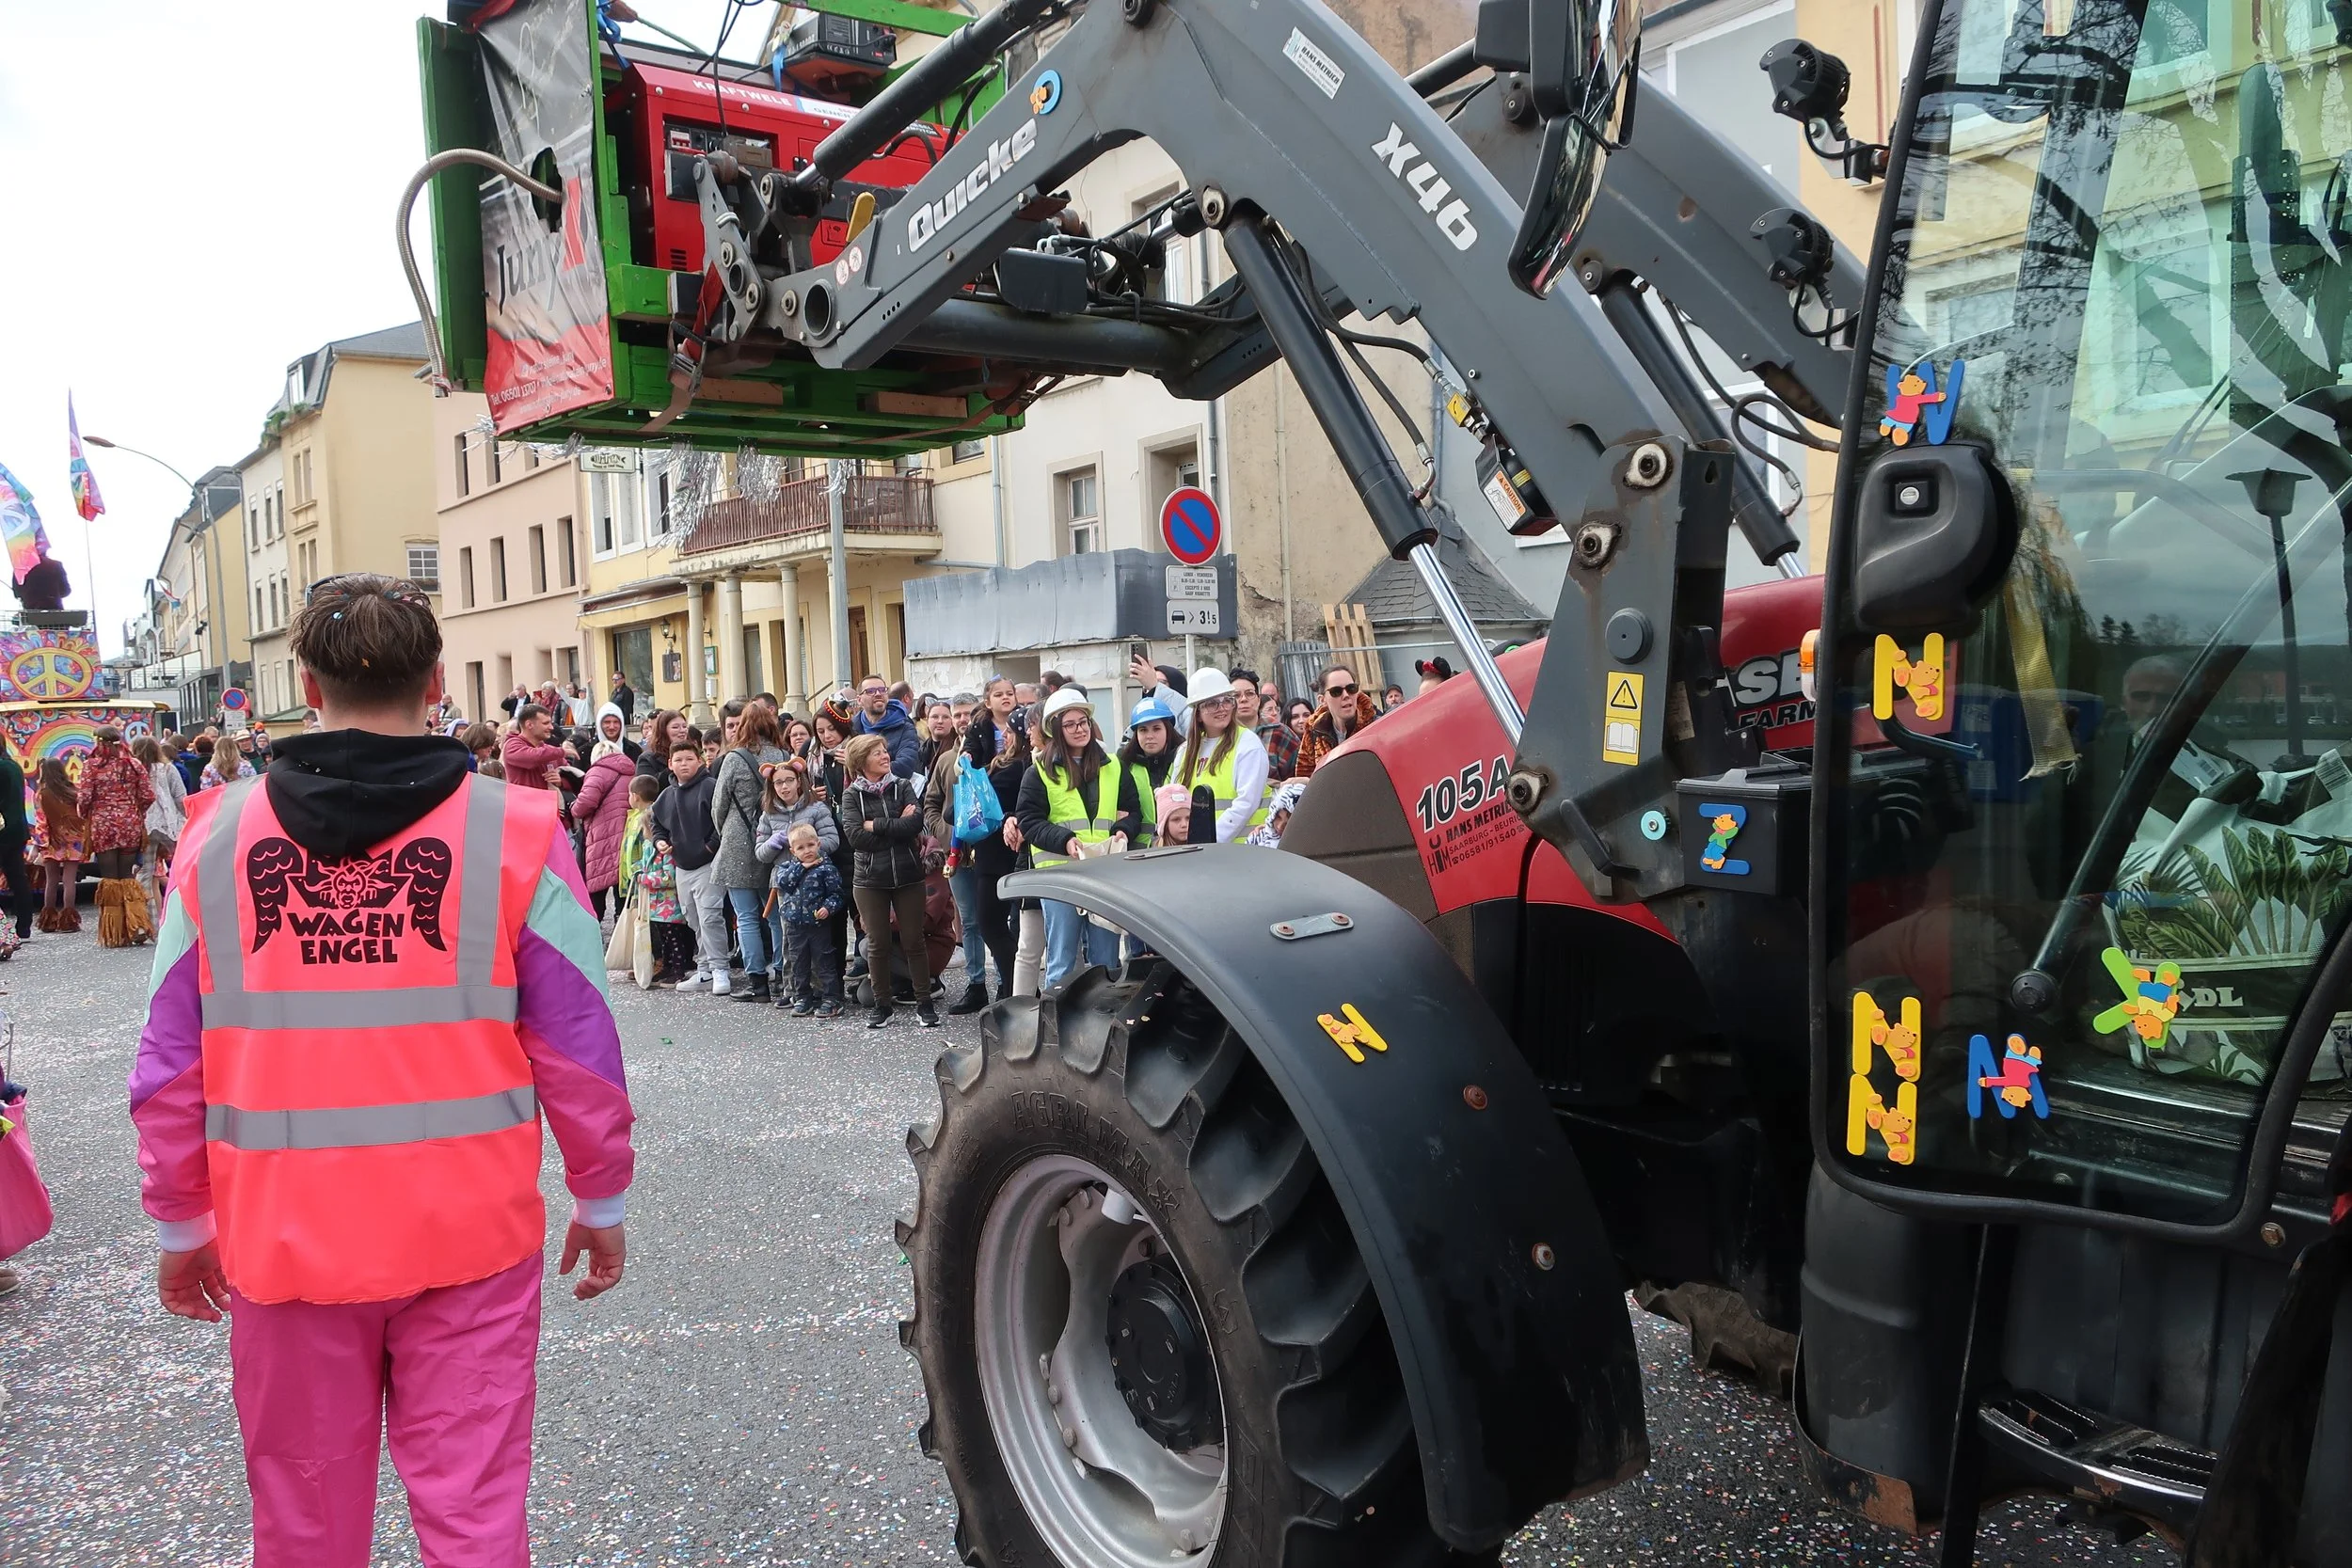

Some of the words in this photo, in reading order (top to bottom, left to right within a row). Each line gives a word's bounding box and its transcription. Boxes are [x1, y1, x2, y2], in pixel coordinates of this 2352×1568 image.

[1300, 45, 1318, 67] HANS
[1316, 58, 1340, 86] METRICH
[692, 79, 792, 106] KRAFTWELE
[908, 118, 1037, 253] Quicke
[1371, 121, 1478, 251] X46
[490, 394, 501, 406] Tel.
[501, 388, 521, 403] 06501
[1503, 483, 1521, 511] CAUTION
[1416, 753, 1510, 833] 105A
[1446, 818, 1473, 843] HANS
[1449, 830, 1488, 854] SAARBURG
[286, 909, 405, 938] WAGEN
[300, 937, 398, 965] ENGEL
